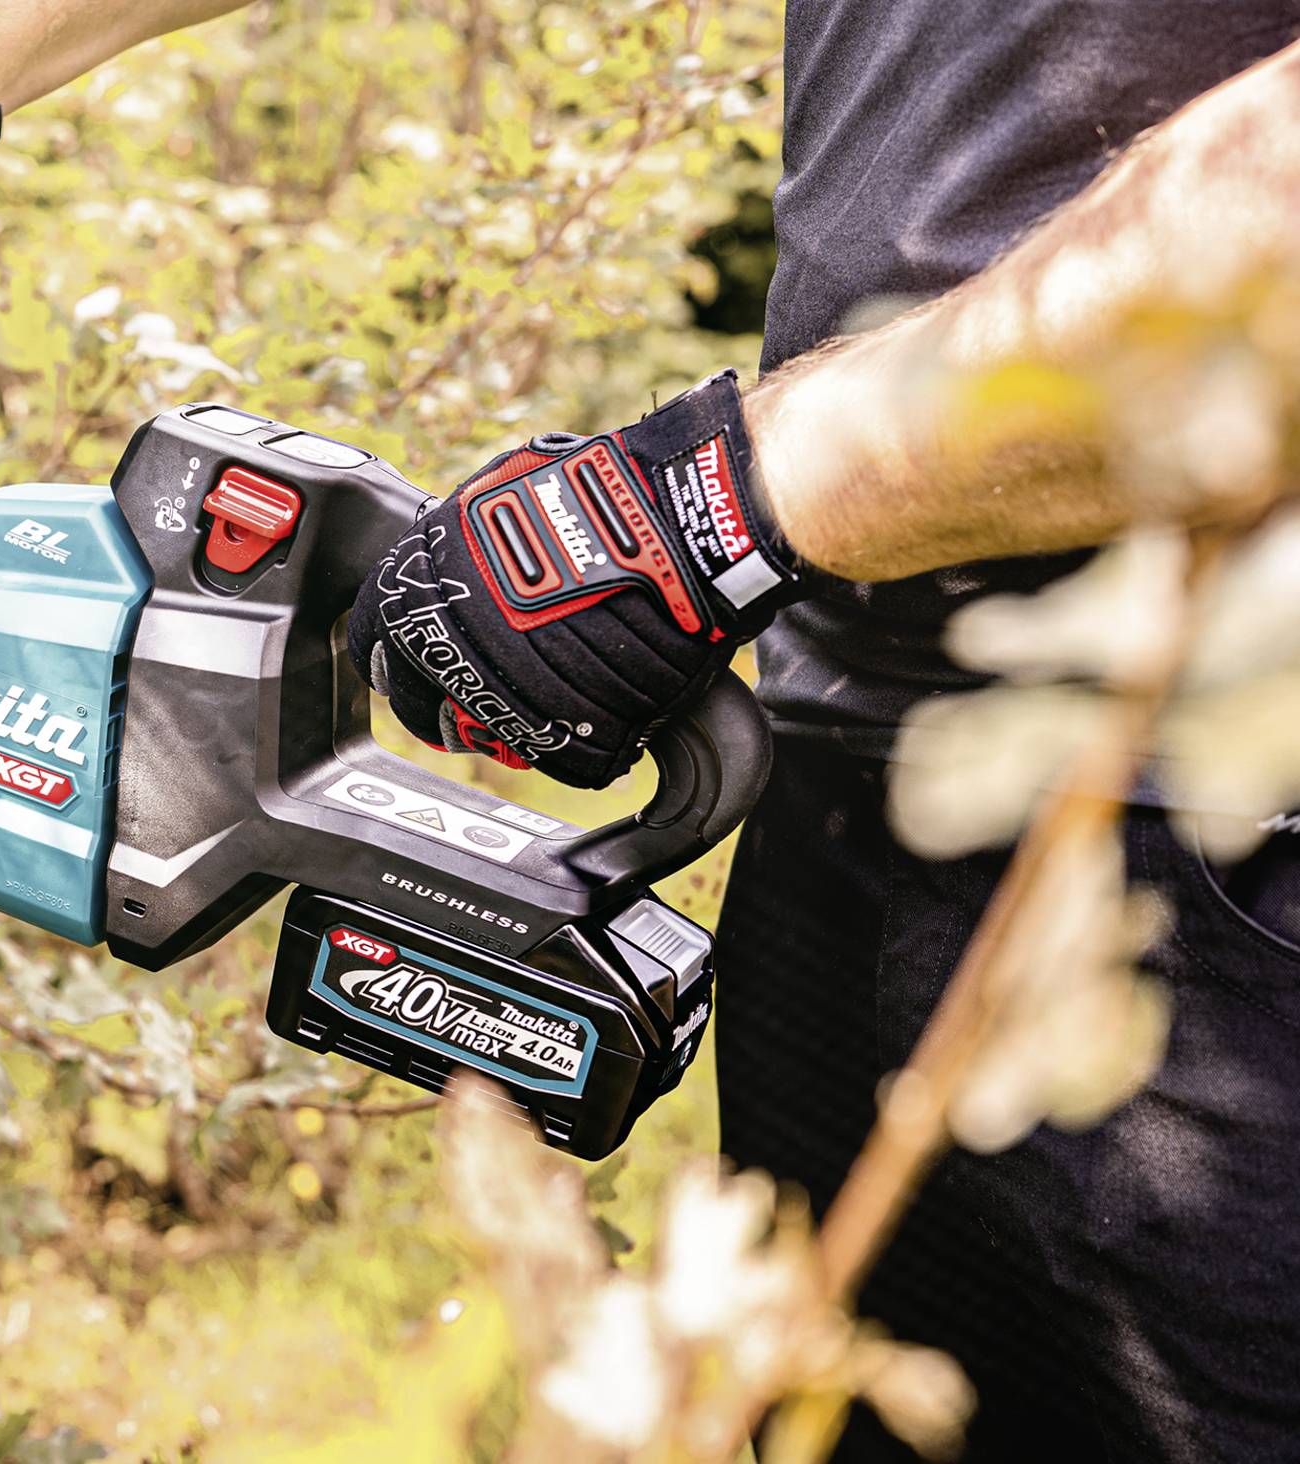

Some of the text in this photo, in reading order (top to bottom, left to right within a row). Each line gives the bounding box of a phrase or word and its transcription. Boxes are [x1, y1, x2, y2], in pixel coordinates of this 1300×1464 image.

[680, 484, 692, 503] THE
[686, 506, 701, 533] NEEDS
[695, 440, 742, 562] Makita
[10, 518, 72, 555] BL
[534, 473, 595, 574] Makita
[700, 516, 711, 530] TO
[706, 533, 723, 558] MEET
[3, 533, 67, 565] MOTOR
[381, 872, 530, 935] BRUSHLESS
[334, 931, 392, 960] XGT
[450, 1025, 508, 1059] max
[499, 1001, 578, 1047] Makita
[519, 1040, 577, 1072] 4.0Ah
